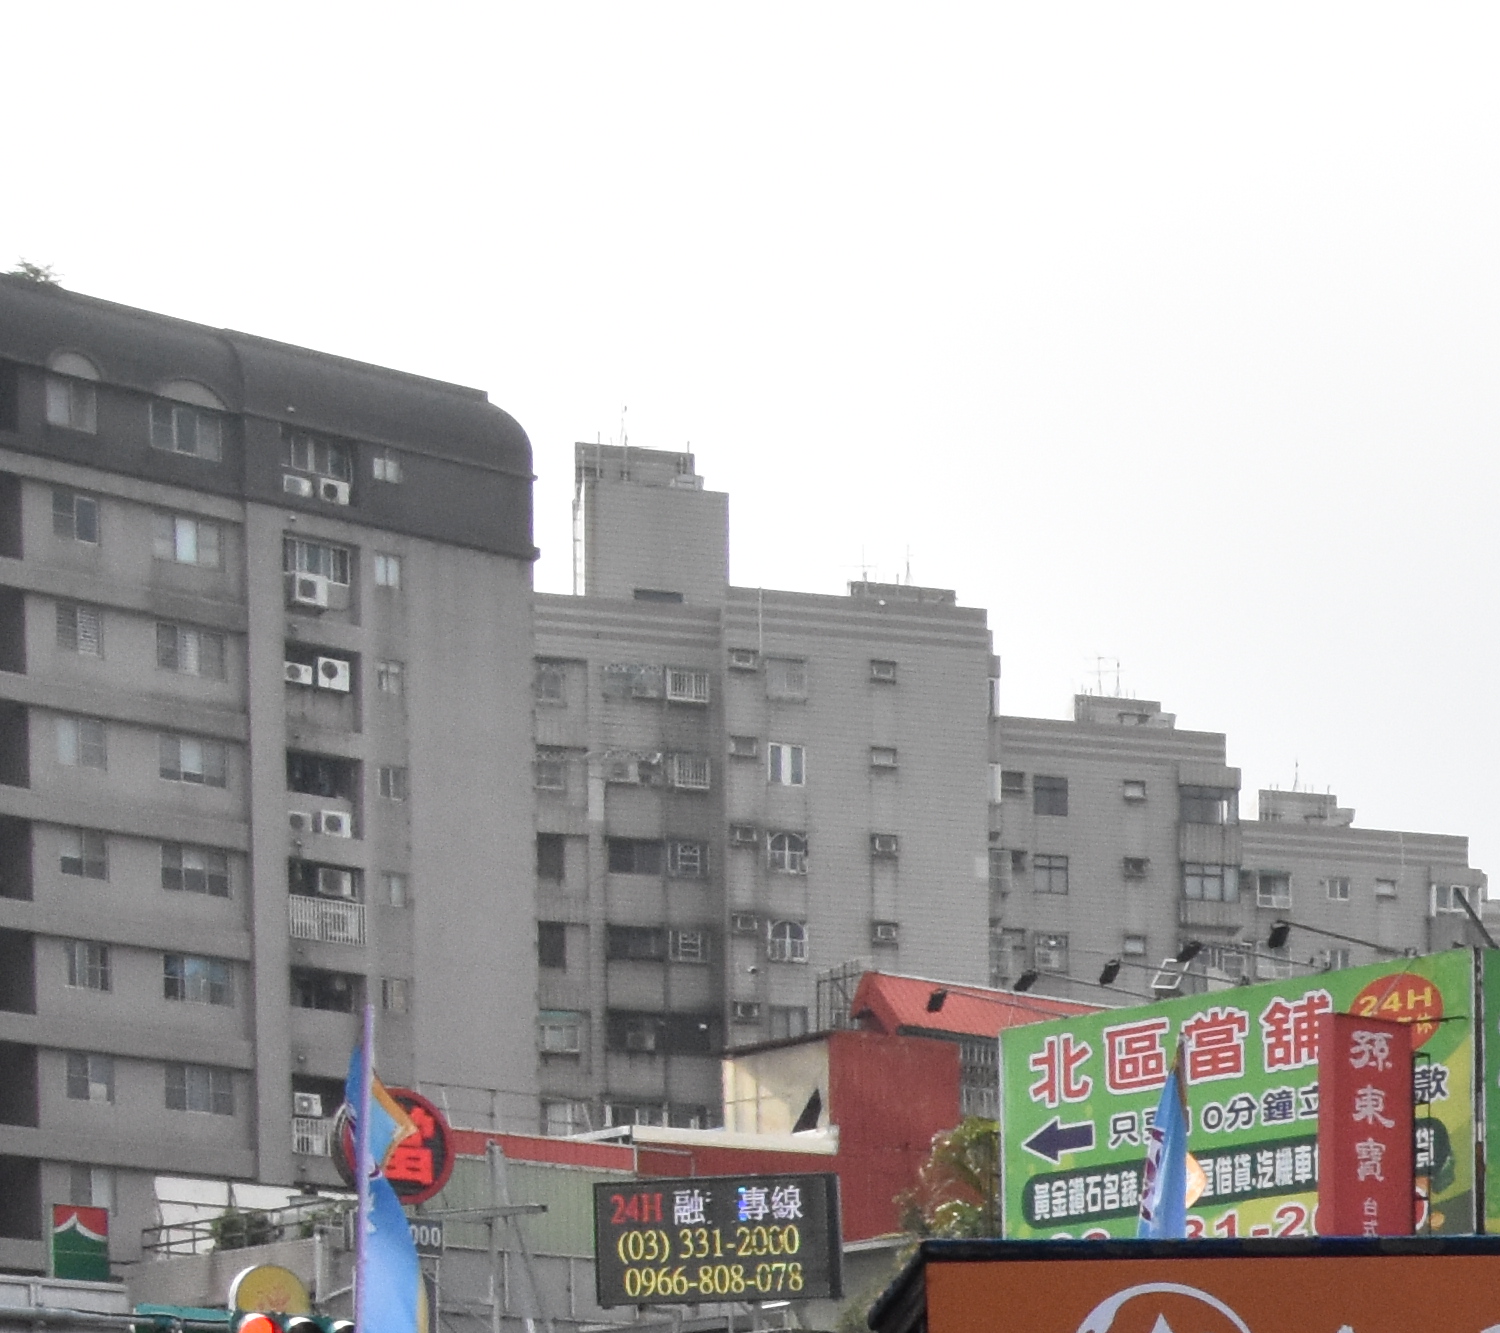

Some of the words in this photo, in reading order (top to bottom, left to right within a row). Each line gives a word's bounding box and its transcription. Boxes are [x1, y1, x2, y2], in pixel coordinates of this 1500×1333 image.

[1350, 1030, 1396, 1182] 孫東寶
[611, 1192, 664, 1225] 24H
[618, 1229, 670, 1265] (03)
[679, 1224, 800, 1259] 331-2000
[625, 1261, 803, 1297] 0966-808-078
